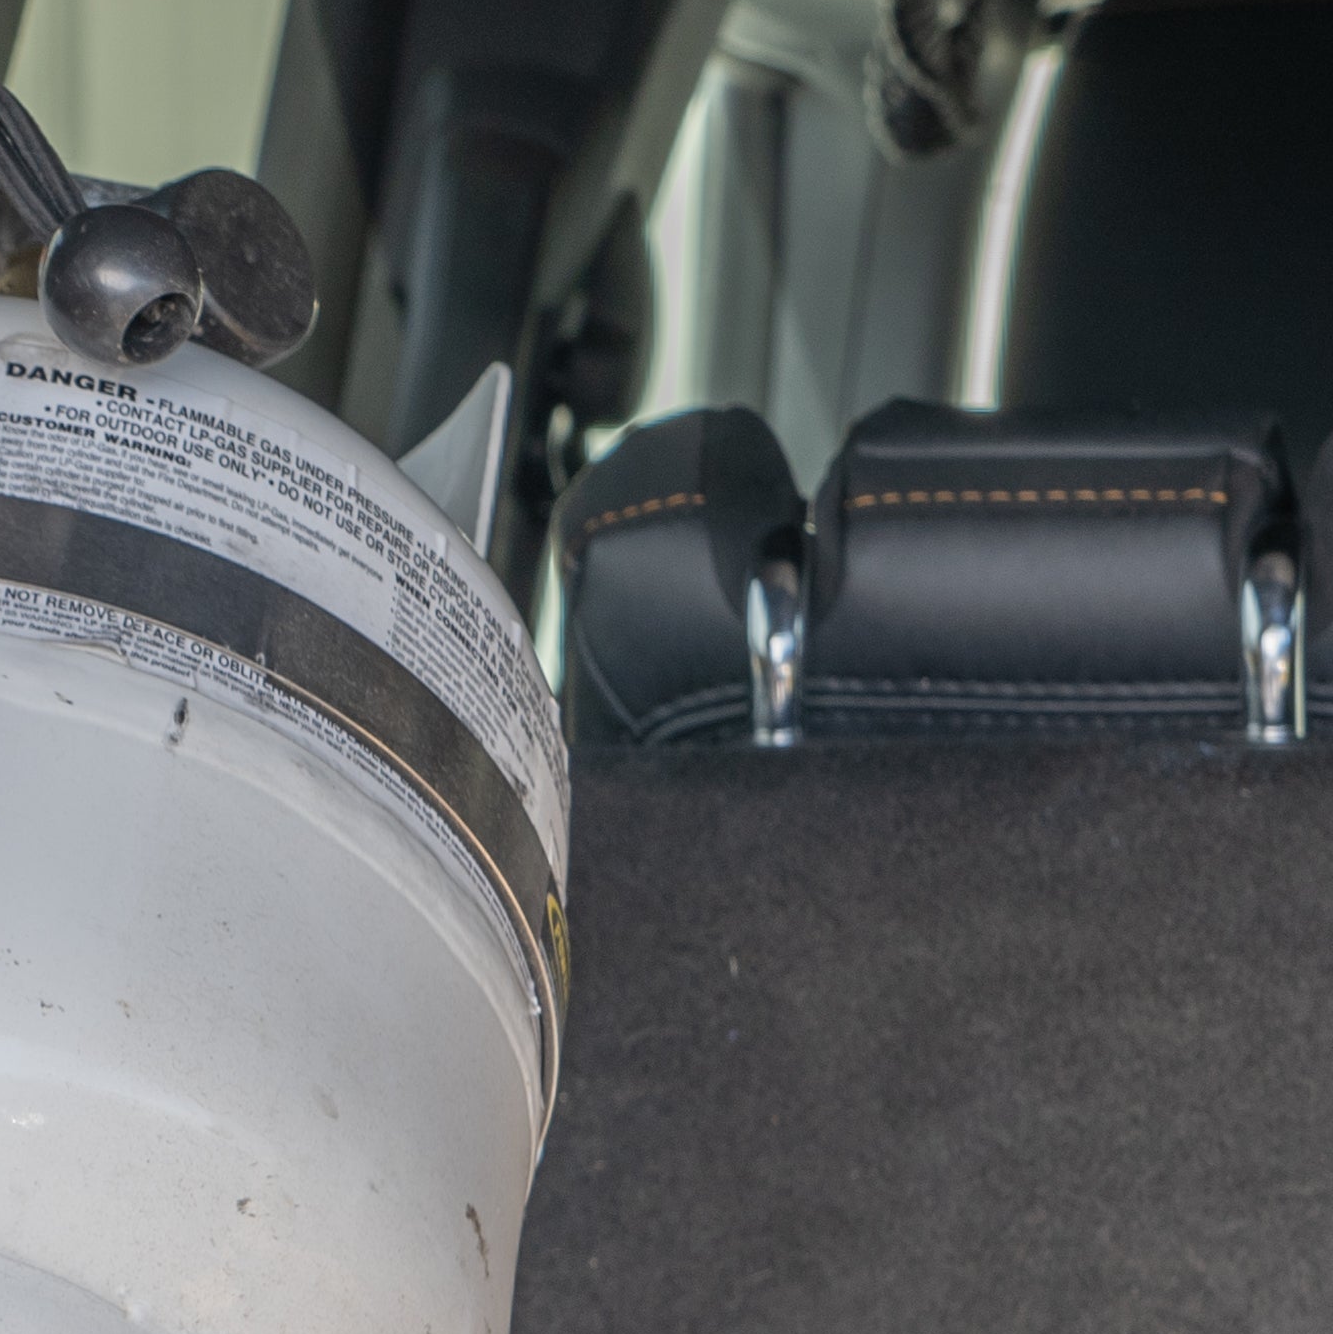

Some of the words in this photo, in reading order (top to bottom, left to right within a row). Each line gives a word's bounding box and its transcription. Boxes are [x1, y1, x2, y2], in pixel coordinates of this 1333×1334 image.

[6, 361, 135, 401] DANGER
[159, 398, 255, 445] FLAMMABLE
[257, 439, 293, 464] GAS
[291, 456, 347, 492] UNDER
[344, 485, 415, 544] PRESSURE
[54, 403, 91, 424] FOR
[95, 413, 178, 448] OUTDOOR
[180, 439, 216, 463] USE
[275, 478, 303, 501] DO
[299, 493, 333, 517] NOT
[332, 513, 365, 539] USE
[361, 534, 386, 556] OR
[382, 550, 427, 588] STORE
[106, 399, 183, 433] CONTACT
[187, 426, 247, 458] LP-GAS
[249, 450, 324, 497] SUPPLIER
[321, 489, 357, 516] FOR
[354, 510, 413, 558] REPAIRS
[409, 551, 434, 575] OR
[4, 587, 41, 605] NOT
[45, 596, 118, 623] REMOVE
[122, 615, 186, 648] DEFACE
[190, 640, 214, 660] OR
[392, 572, 432, 609] WHEN
